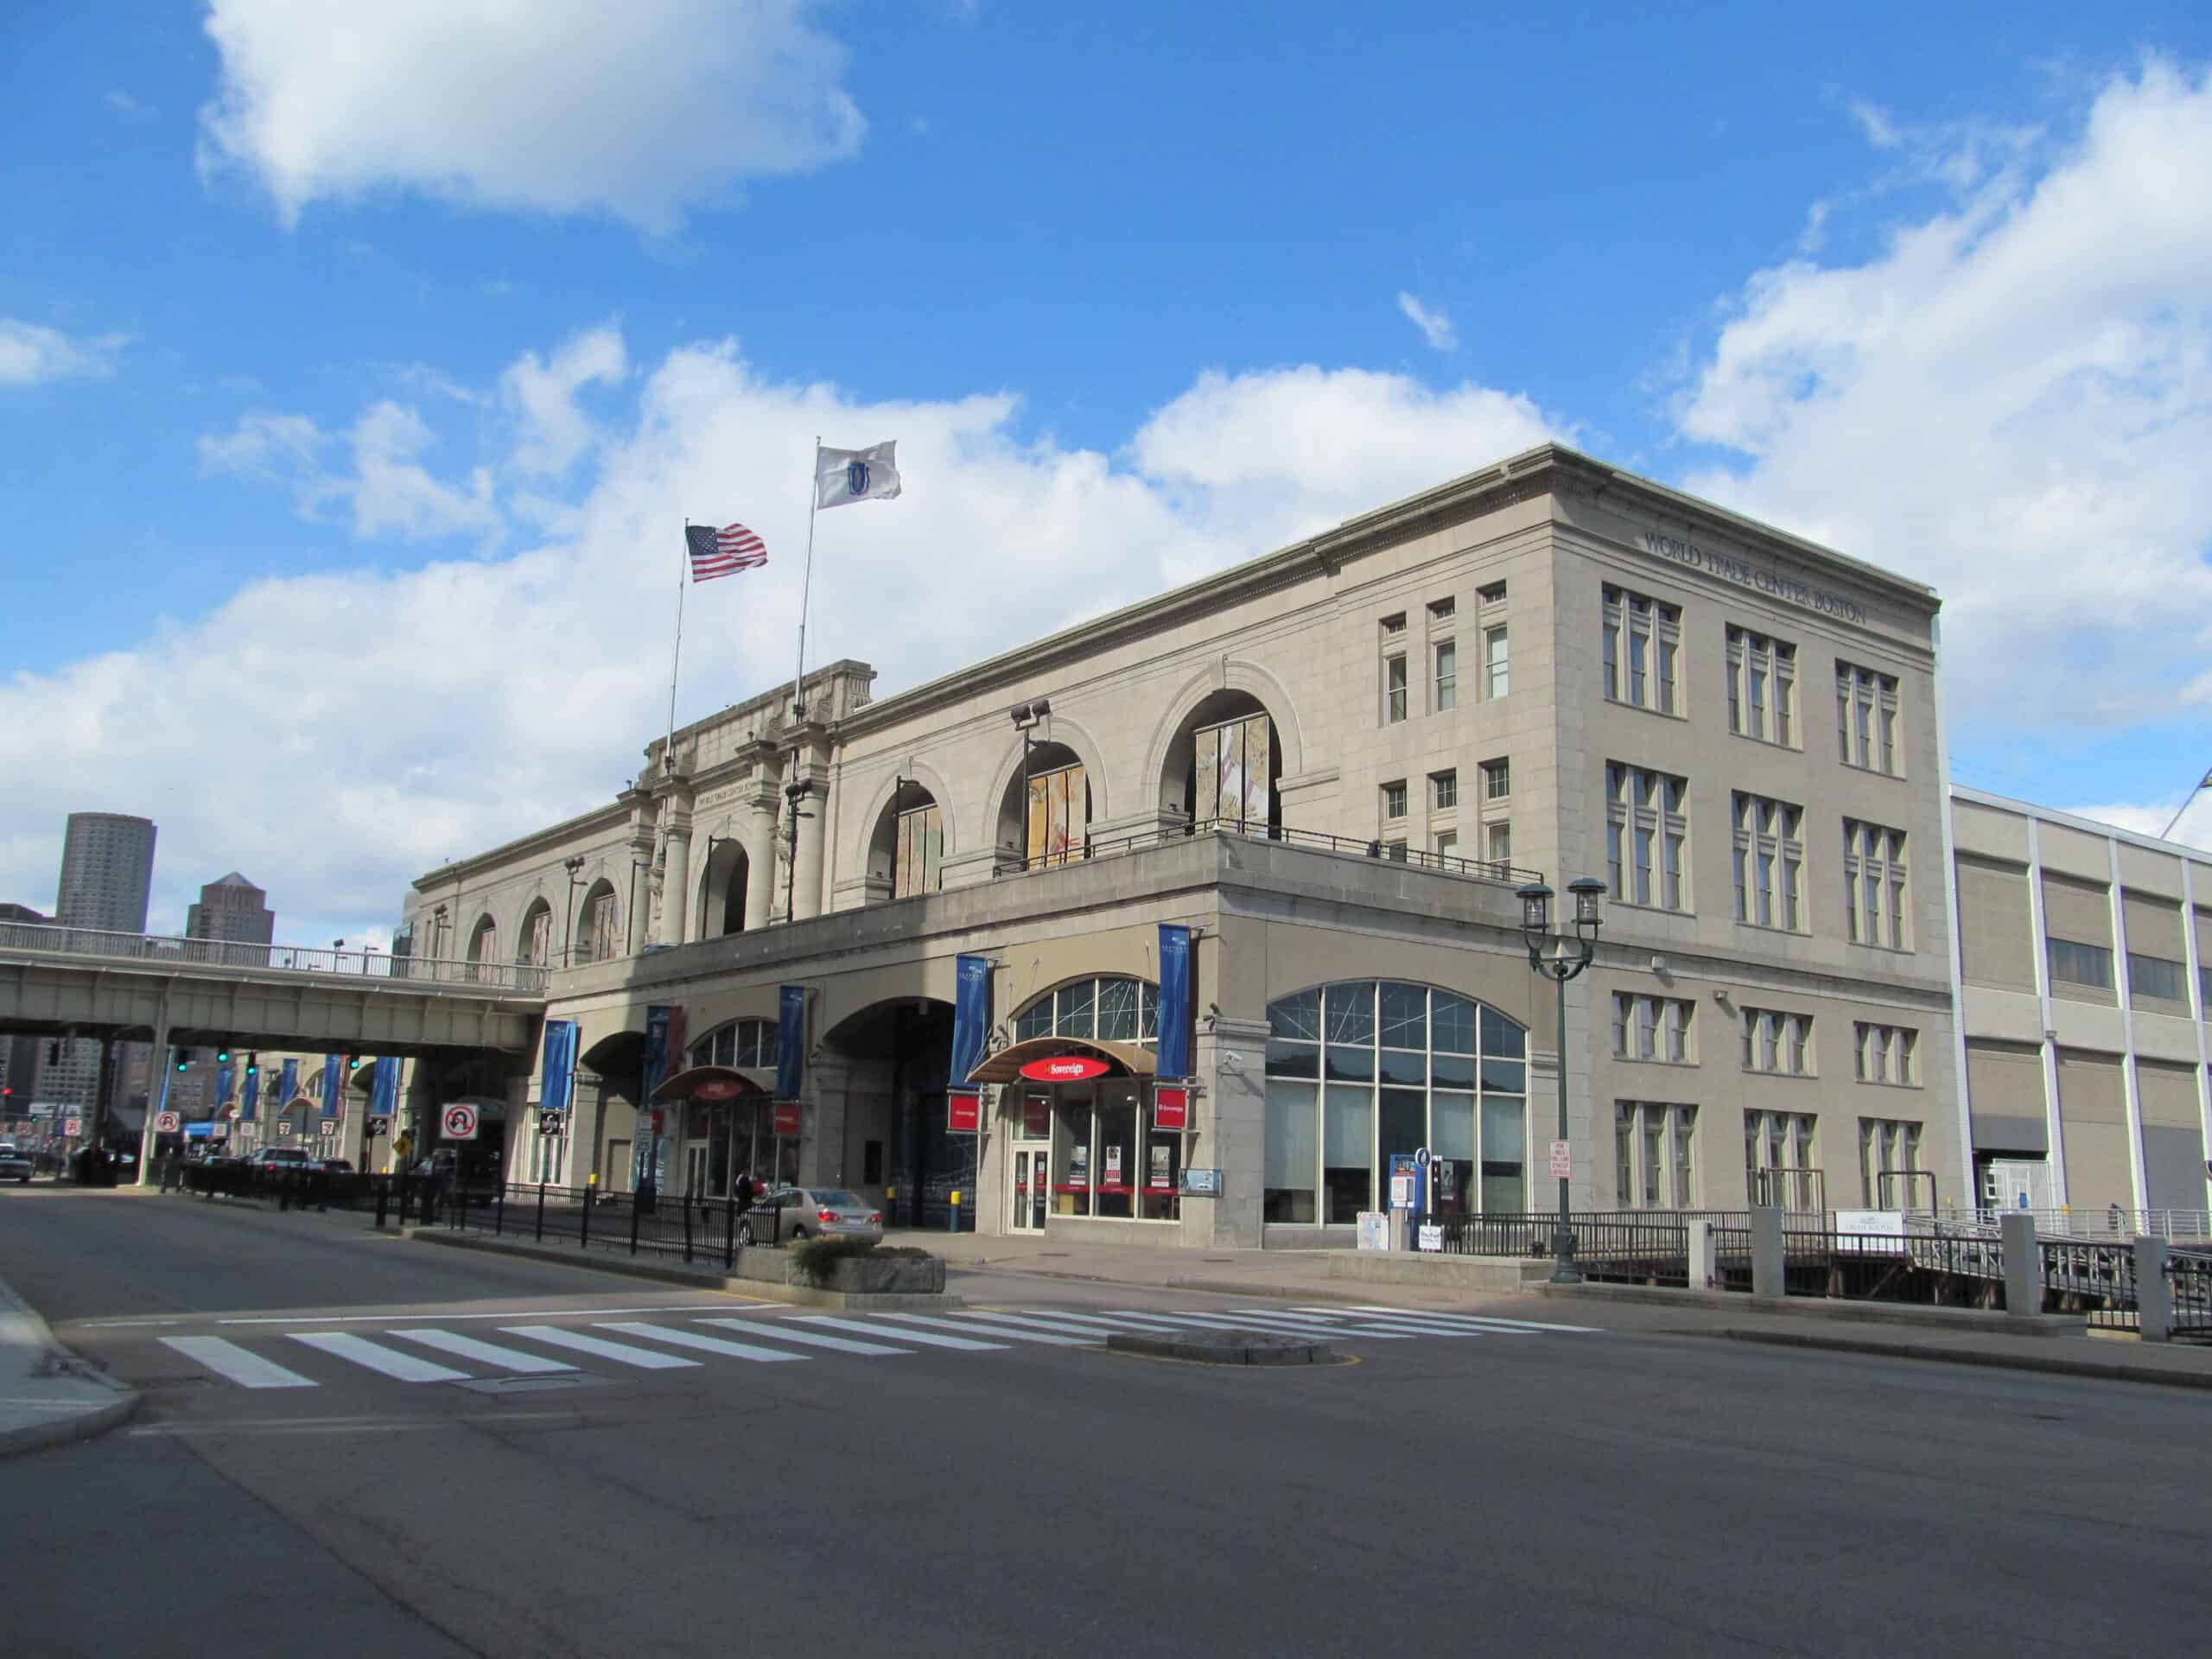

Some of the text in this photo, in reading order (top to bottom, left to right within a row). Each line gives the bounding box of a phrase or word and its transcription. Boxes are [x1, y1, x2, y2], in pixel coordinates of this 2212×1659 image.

[1645, 531, 1866, 625] WORLD TRADE CENTER BOSTON
[1051, 1063, 1084, 1077] Sovereign
